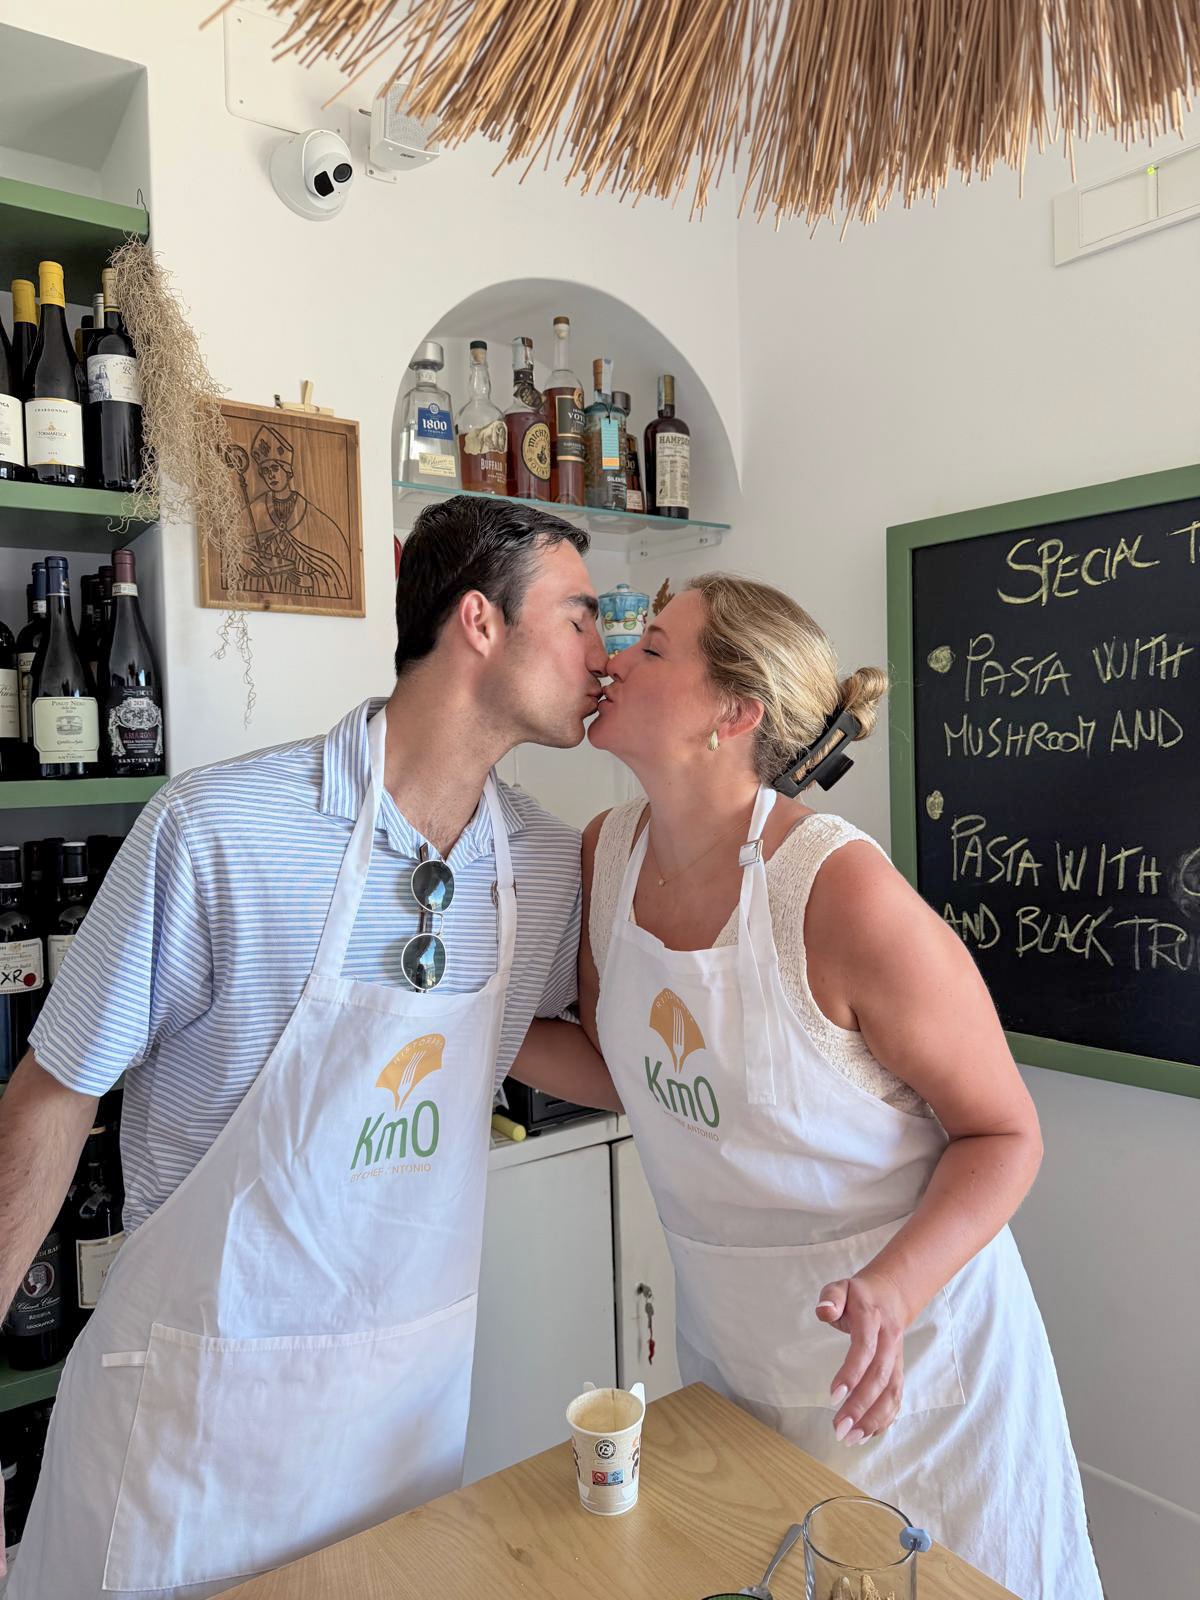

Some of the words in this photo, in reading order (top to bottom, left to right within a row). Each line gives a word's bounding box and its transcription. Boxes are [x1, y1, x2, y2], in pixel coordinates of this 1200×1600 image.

[422, 418, 447, 431] 1800
[998, 535, 1160, 606] SPECIAL
[965, 633, 1072, 702] PASTA
[1092, 633, 1194, 684] WITH
[944, 713, 1096, 759] MUSHROOM
[1110, 707, 1184, 752] AND
[951, 814, 1044, 887] PASTA
[1055, 840, 1162, 897] WITH
[943, 902, 1000, 950] AND
[1016, 904, 1115, 967] BLACK
